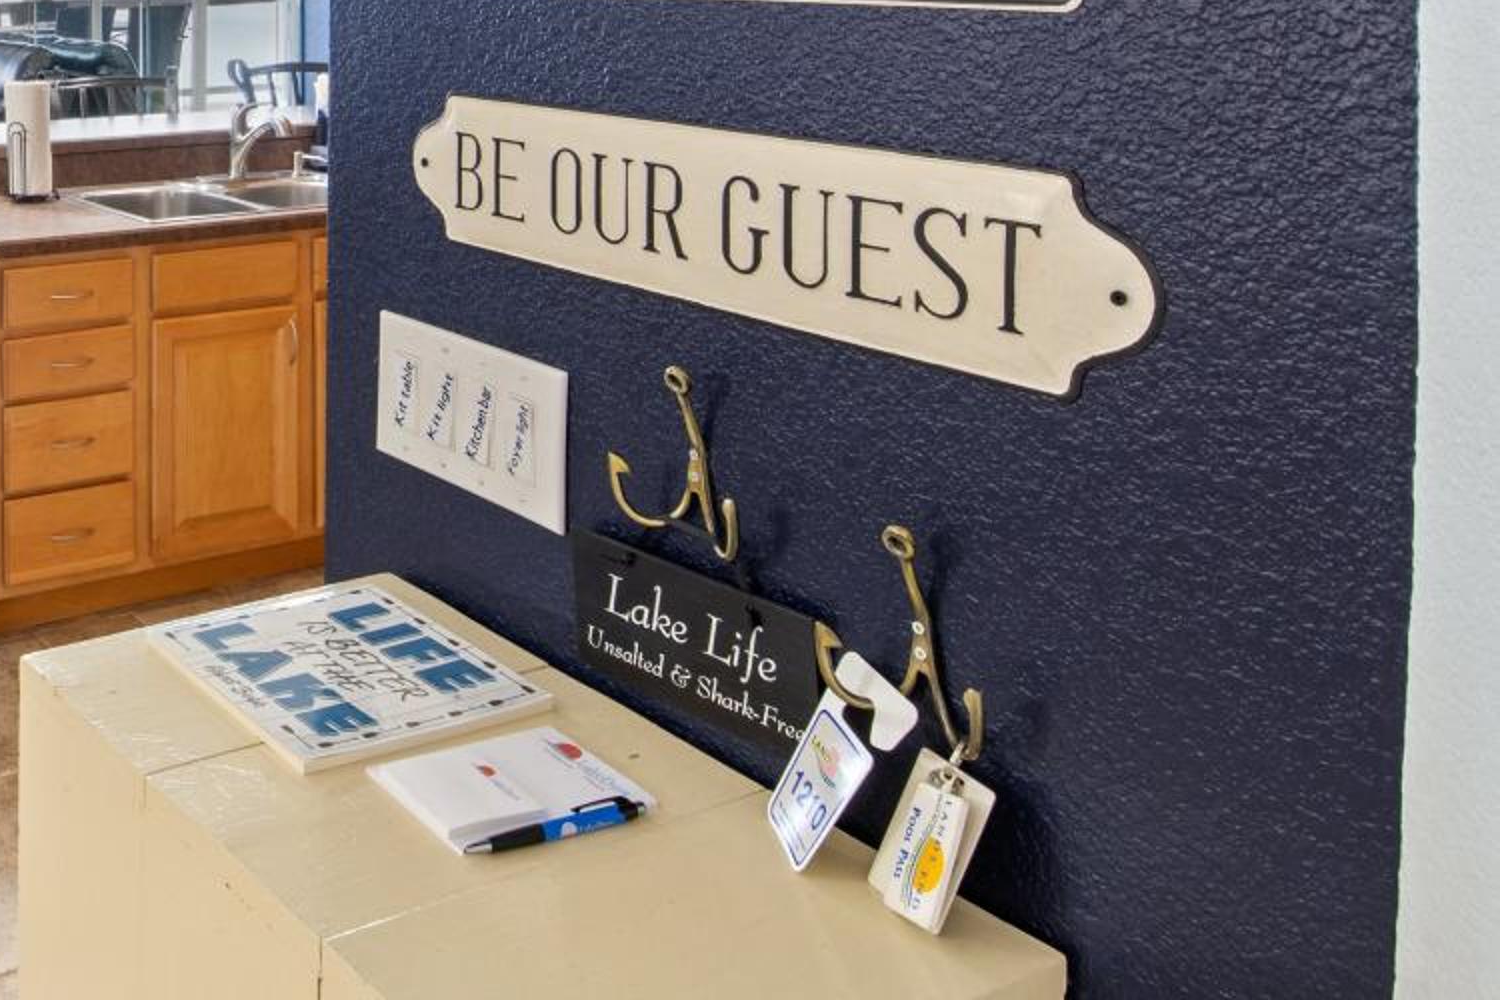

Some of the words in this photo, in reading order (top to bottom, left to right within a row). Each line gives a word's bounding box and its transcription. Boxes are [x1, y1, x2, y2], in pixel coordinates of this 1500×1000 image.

[454, 131, 526, 222] BE
[549, 147, 689, 260] OUR
[720, 175, 1042, 336] GUEST
[438, 373, 454, 410] light
[465, 410, 489, 460] Kitchen
[328, 601, 496, 694] LIFE
[587, 625, 664, 678] Unsalted
[670, 664, 693, 689] &
[604, 573, 689, 644] Lake
[703, 613, 777, 683] Life
[192, 622, 380, 738] LAKE
[313, 661, 375, 692] THE
[325, 639, 429, 701] BETTER
